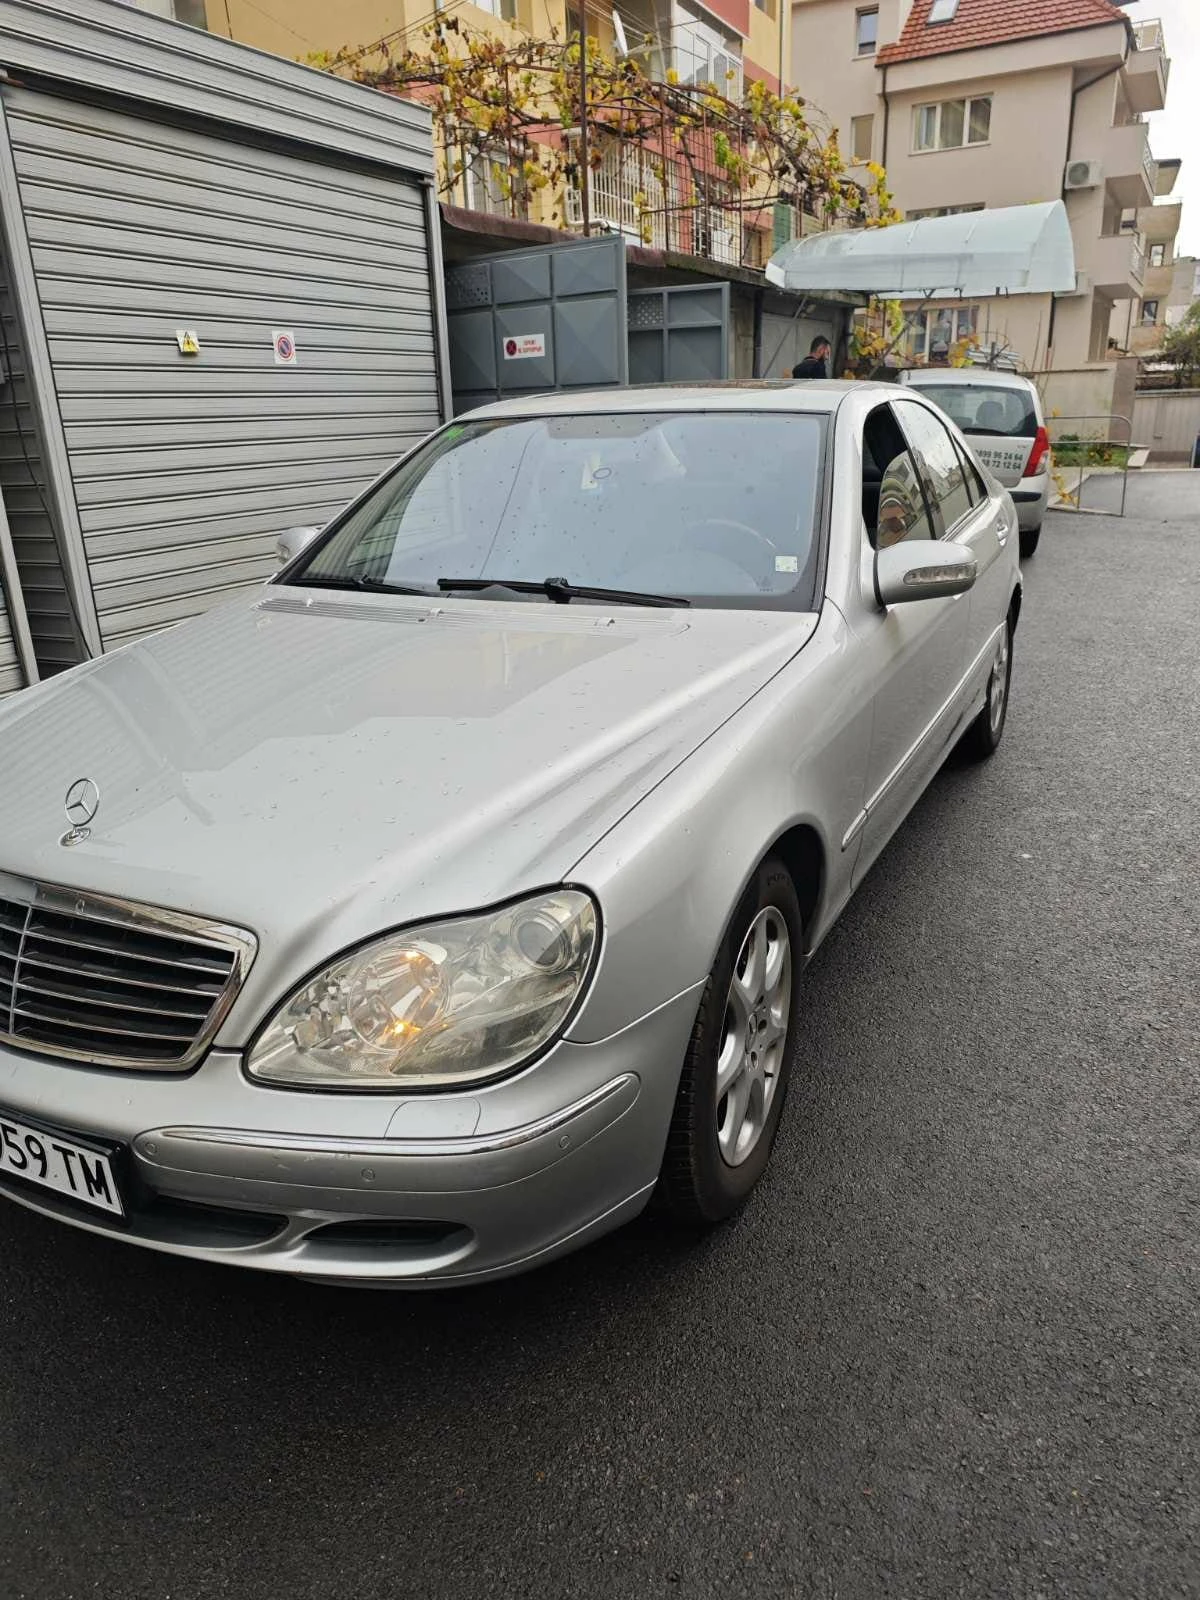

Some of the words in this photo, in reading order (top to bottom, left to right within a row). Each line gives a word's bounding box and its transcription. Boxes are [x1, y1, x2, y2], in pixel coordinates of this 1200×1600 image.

[992, 460, 1001, 468] 72
[1003, 461, 1011, 469] 12
[0, 1122, 47, 1178] 59
[52, 1143, 113, 1205] TM
